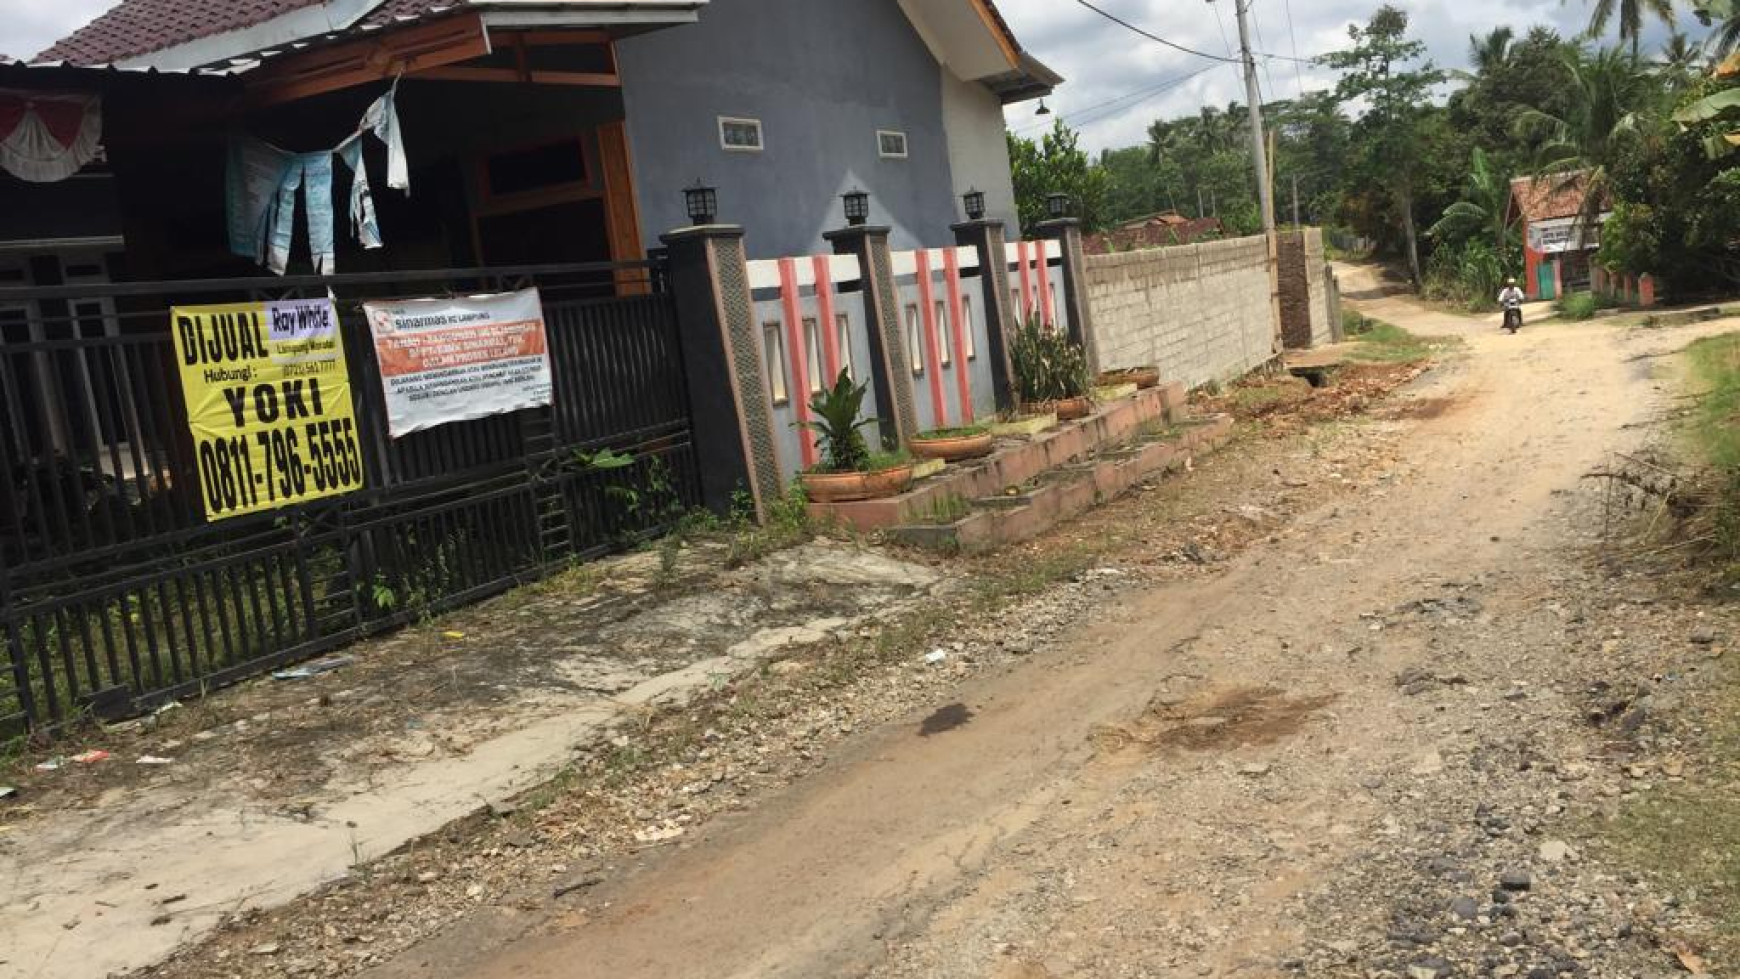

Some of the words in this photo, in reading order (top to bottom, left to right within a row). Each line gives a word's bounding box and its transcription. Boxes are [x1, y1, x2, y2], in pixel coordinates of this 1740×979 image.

[178, 311, 269, 366] DIJUAL
[271, 307, 296, 336] Ray
[223, 378, 324, 428] YOKI
[199, 417, 362, 514] 0811-796-5555
